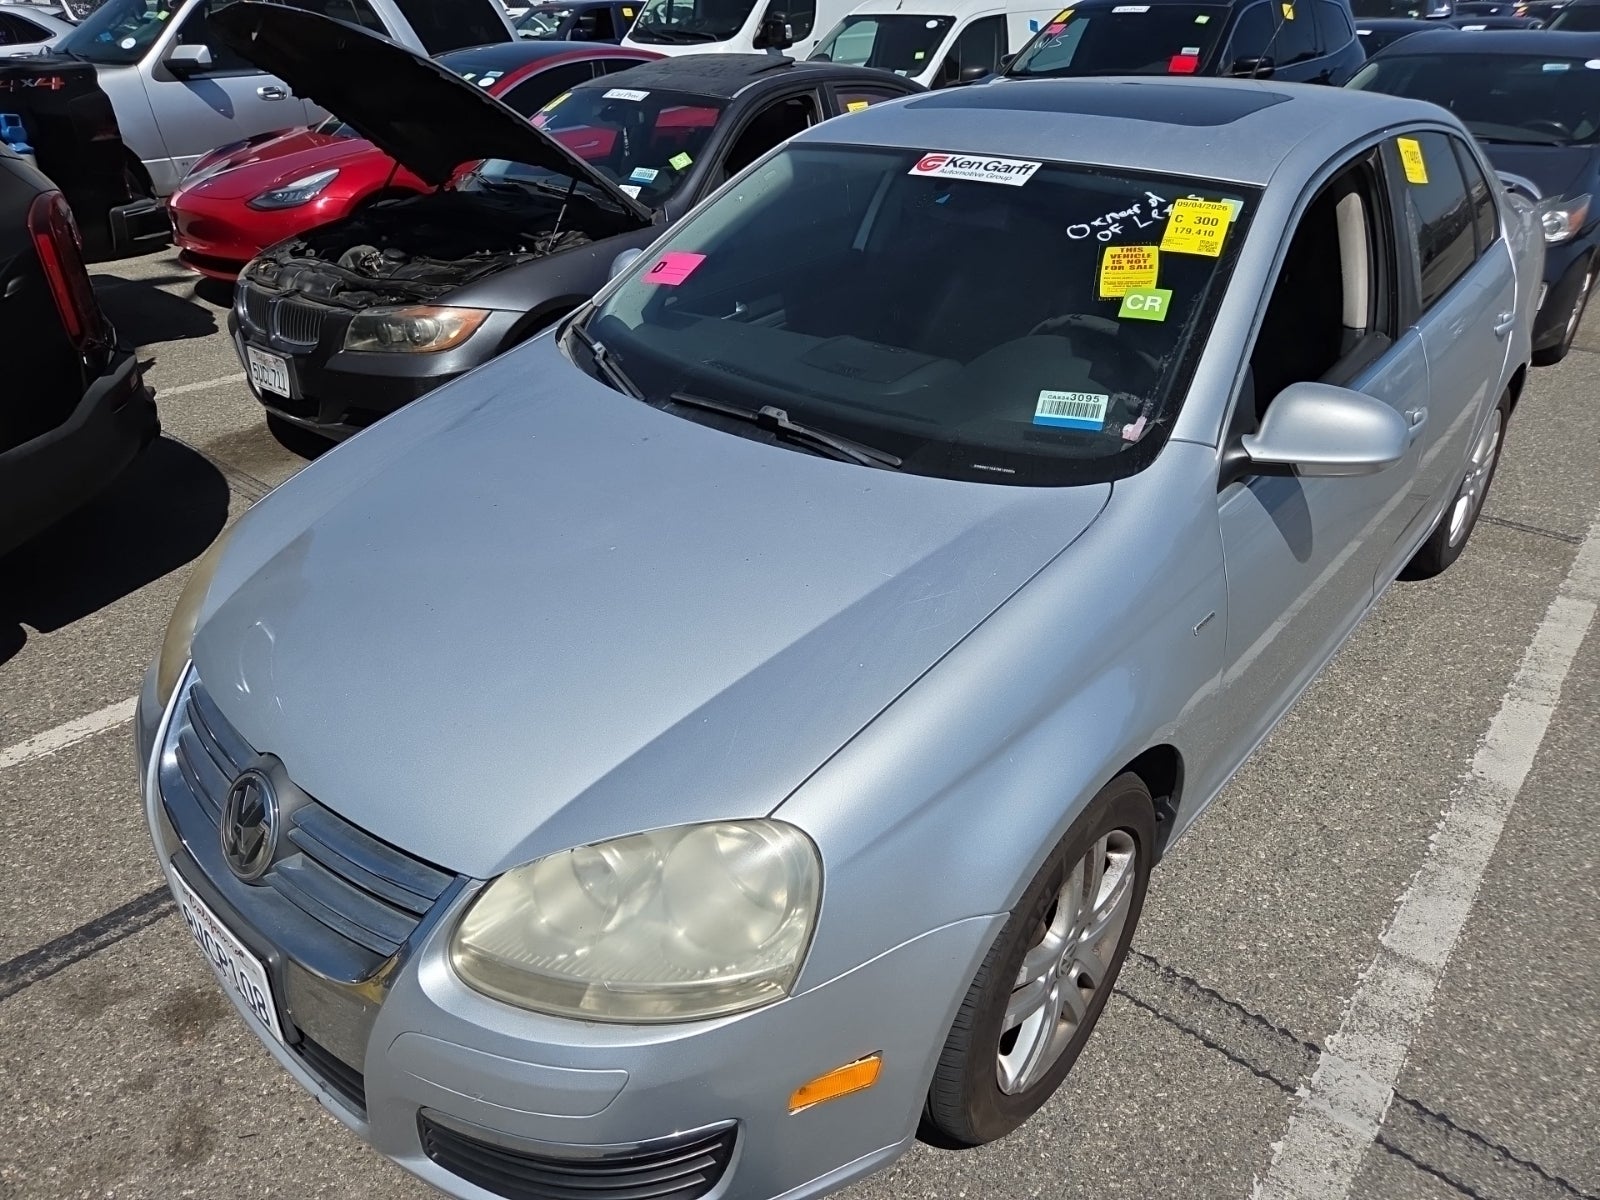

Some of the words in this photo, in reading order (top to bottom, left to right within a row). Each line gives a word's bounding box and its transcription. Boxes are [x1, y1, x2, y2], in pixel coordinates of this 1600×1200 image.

[944, 156, 983, 170] Ken
[938, 168, 985, 178] Automotive
[986, 173, 1013, 182] Group
[1177, 201, 1228, 211] 09/04/2026
[1175, 214, 1184, 223] C
[1193, 216, 1219, 226] 300
[651, 261, 668, 273] D
[1126, 294, 1162, 312] CR
